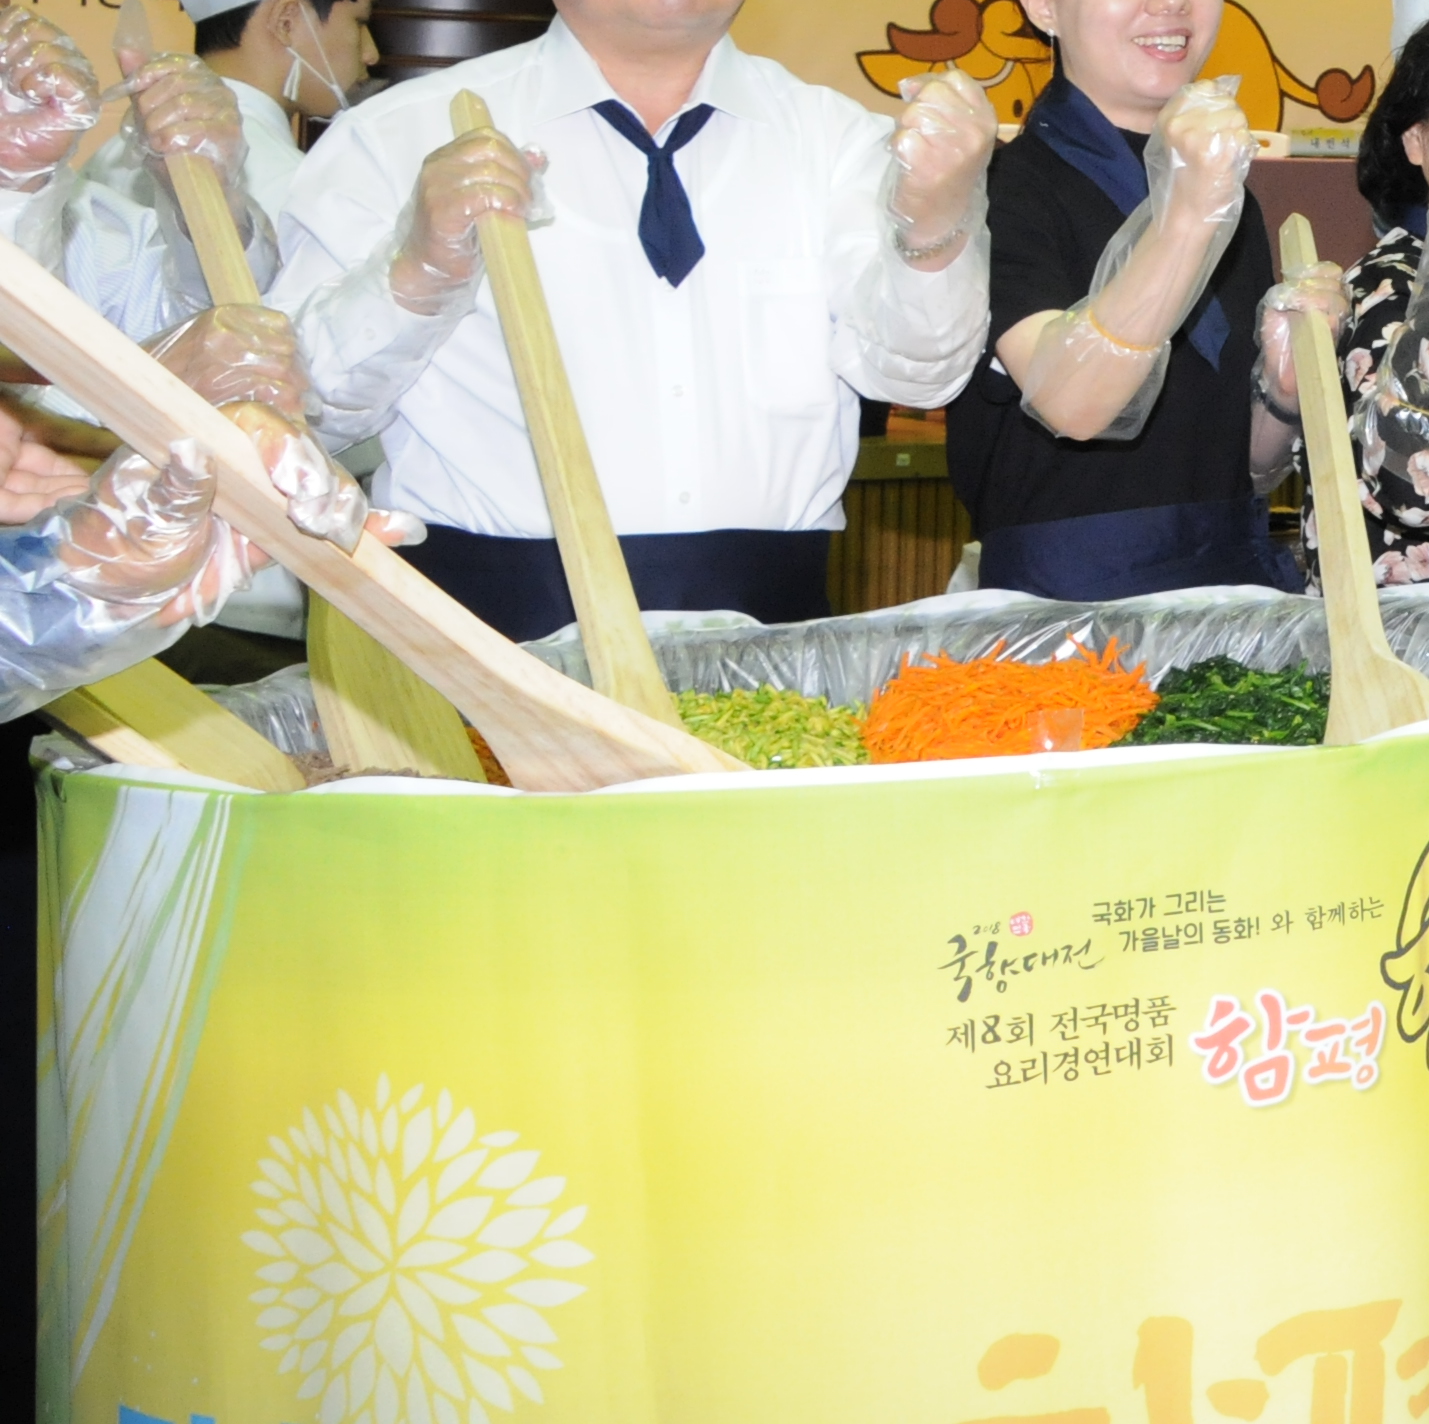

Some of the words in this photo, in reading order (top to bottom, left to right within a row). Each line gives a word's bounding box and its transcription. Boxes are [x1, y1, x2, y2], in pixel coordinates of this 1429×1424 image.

[1092, 895, 1156, 926] 국화가
[1163, 889, 1227, 917] 그리는
[1118, 921, 1203, 954] 가을날의
[1211, 917, 1260, 945] 동화!
[1270, 910, 1295, 934] 와
[1304, 896, 1385, 931] 함께하는
[945, 1012, 1036, 1054] 제8회
[1048, 995, 1177, 1042] 전국명품
[1191, 989, 1386, 1105] 함평
[985, 1034, 1174, 1090] 요리경연대회
